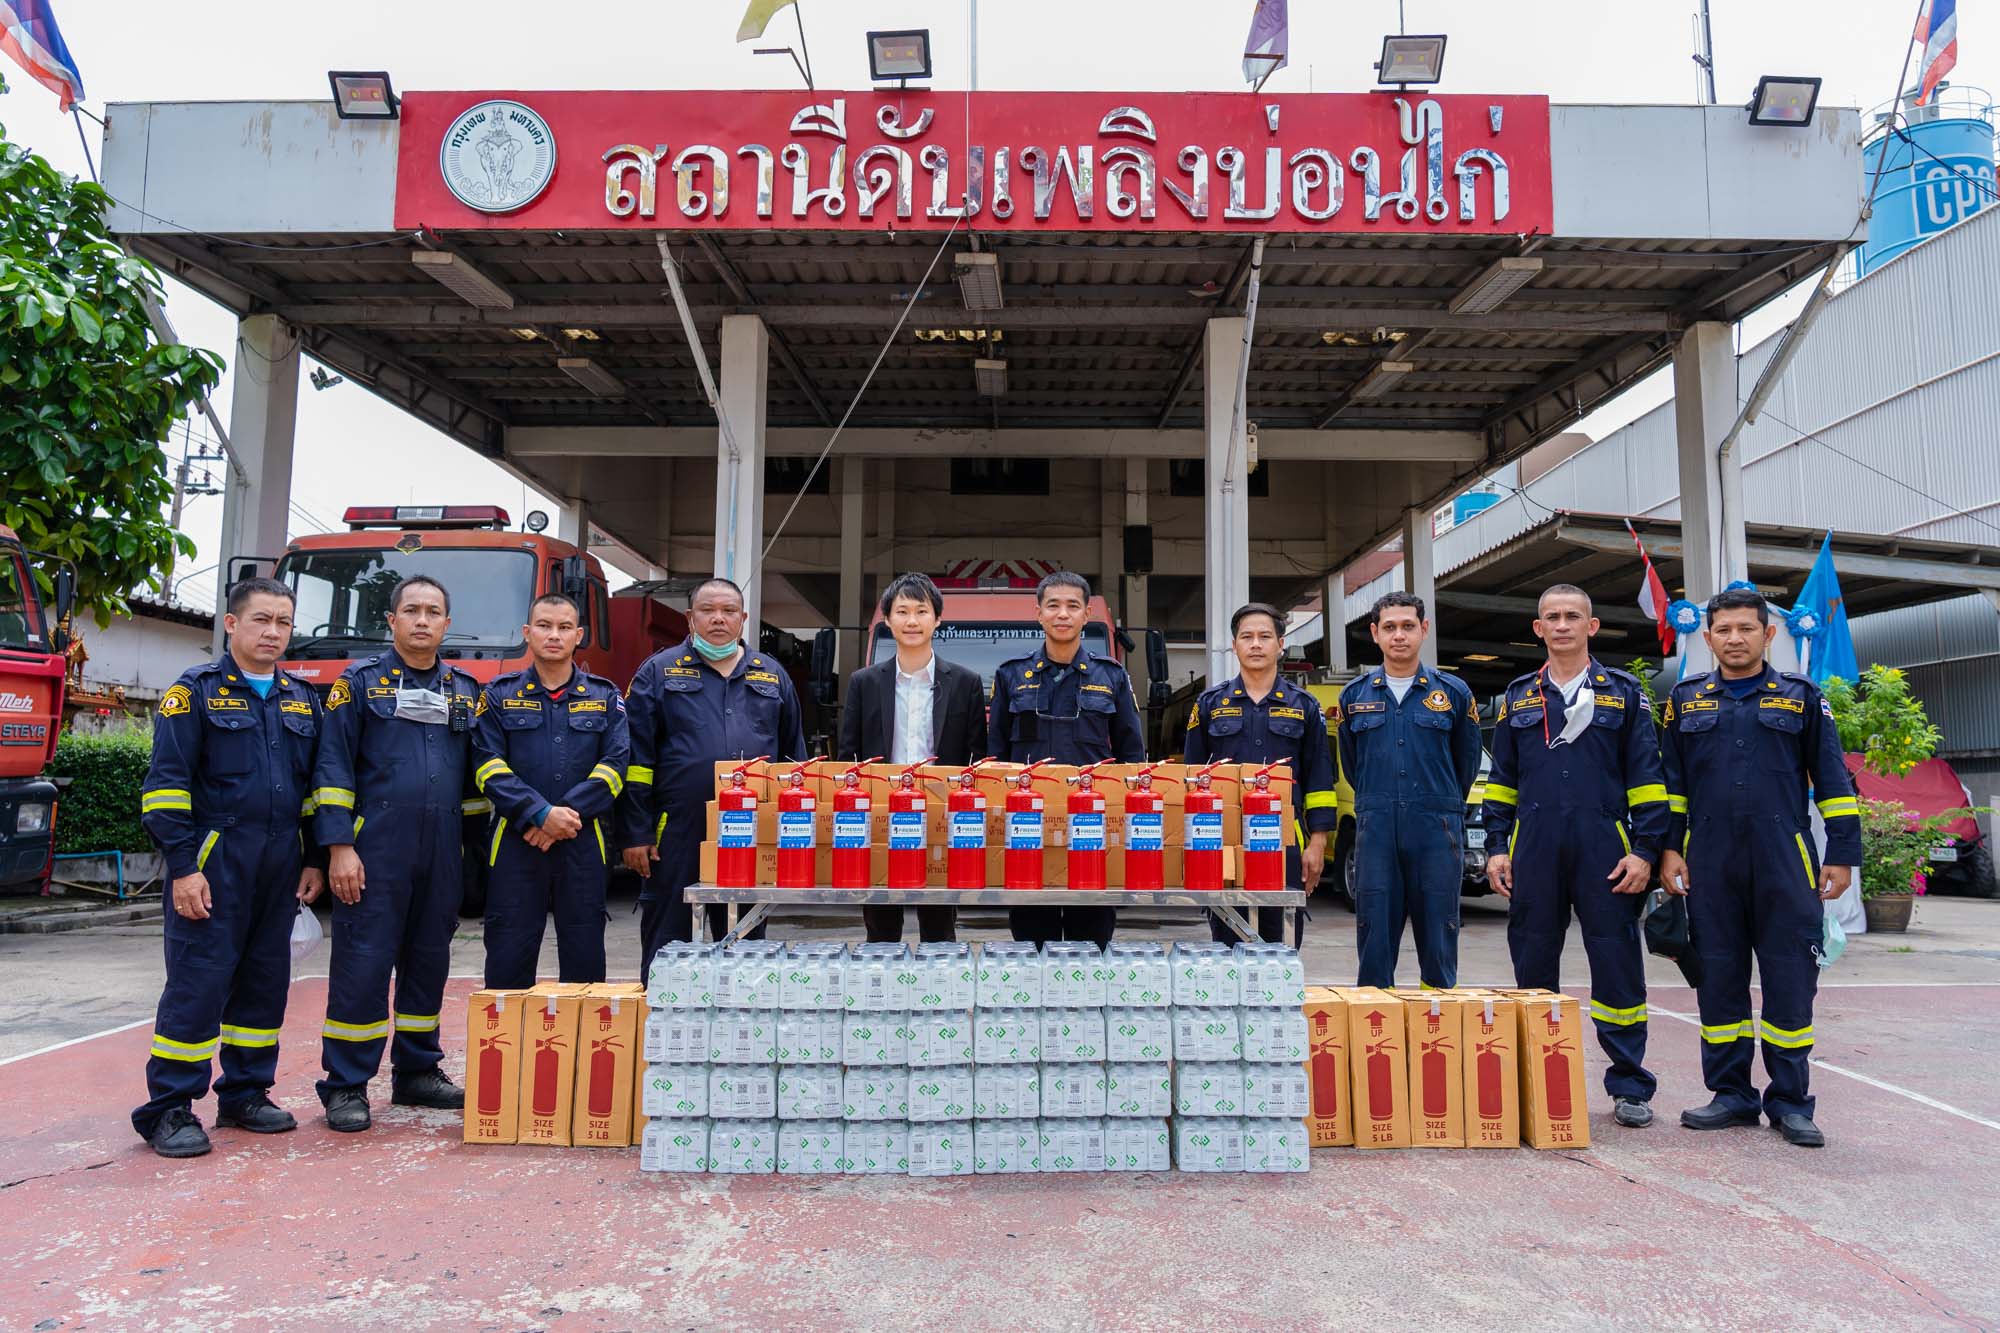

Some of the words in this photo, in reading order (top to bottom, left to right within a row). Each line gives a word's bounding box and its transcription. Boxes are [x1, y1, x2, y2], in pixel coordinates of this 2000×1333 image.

[602, 98, 1510, 223] สถานีดับเพลิงบ่อนไก่
[2, 724, 47, 738] STEYR
[543, 1024, 556, 1032] UP
[600, 1024, 612, 1032] UP
[1428, 1026, 1440, 1034] UP
[1482, 1027, 1494, 1035] UP
[1316, 1029, 1328, 1037] UP
[1371, 1029, 1383, 1038] UP
[1548, 1028, 1561, 1037] UP
[480, 1119, 499, 1127] SIZE
[534, 1120, 554, 1128] SIZE
[589, 1121, 609, 1129] SIZE
[1317, 1122, 1336, 1130] SIZE
[1426, 1121, 1446, 1129] SIZE
[1482, 1123, 1502, 1131] SIZE
[1373, 1124, 1393, 1132] SIZE
[1551, 1124, 1572, 1132] SIZE
[479, 1129, 484, 1137] 5
[487, 1129, 499, 1137] LB
[533, 1129, 539, 1137] 5
[541, 1129, 554, 1137] LB
[588, 1131, 593, 1139] 5
[597, 1131, 609, 1139] LB
[1317, 1132, 1322, 1140] 5
[1325, 1132, 1337, 1140] LB
[1427, 1131, 1432, 1139] 5
[1435, 1131, 1447, 1139] LB
[1482, 1133, 1487, 1141] 5
[1490, 1133, 1503, 1141] LB
[1373, 1134, 1378, 1142] 5
[1381, 1134, 1393, 1142] LB
[1552, 1134, 1558, 1142] 5
[1560, 1134, 1574, 1142] LB
